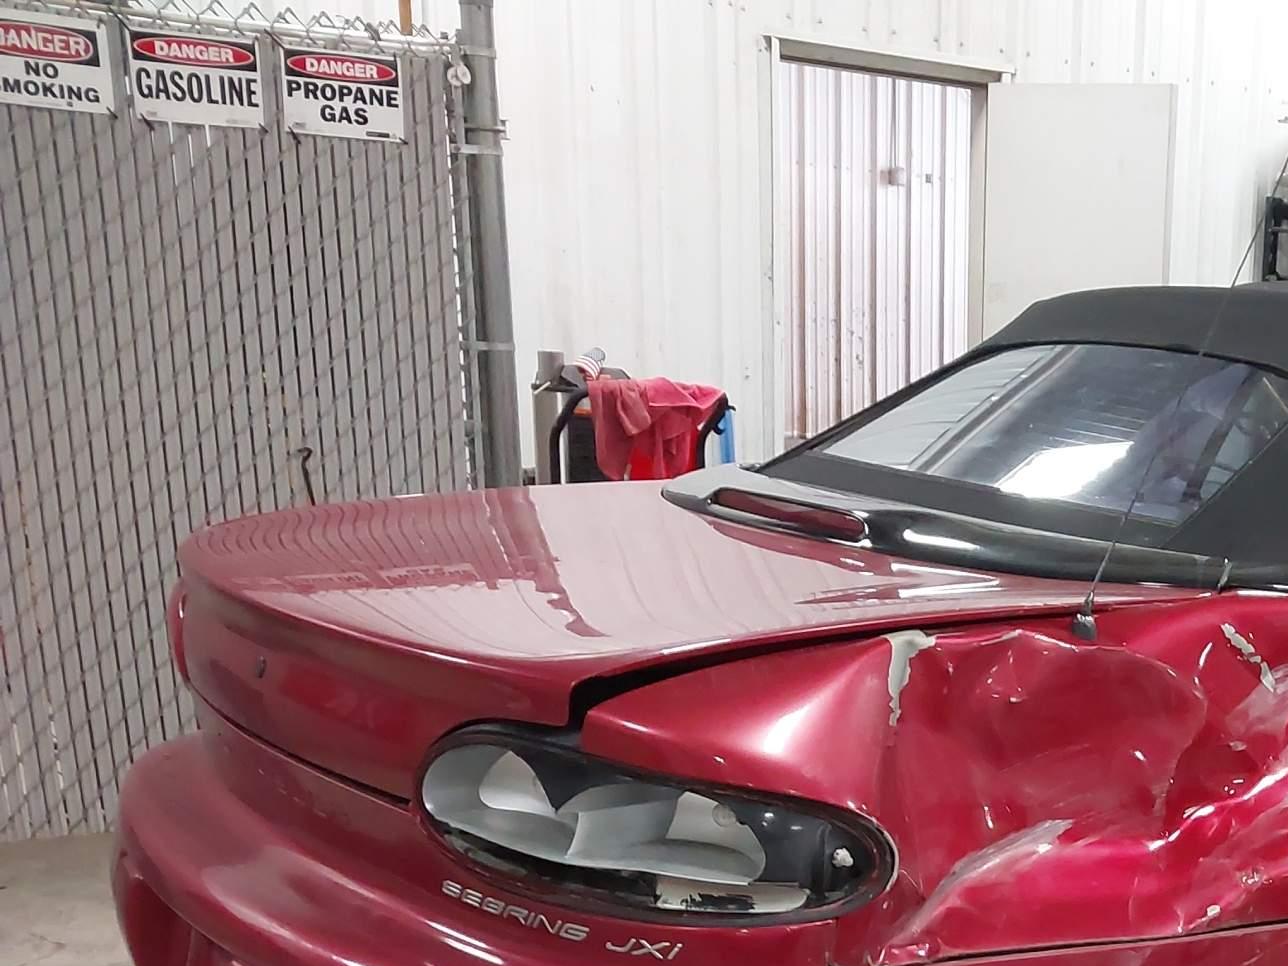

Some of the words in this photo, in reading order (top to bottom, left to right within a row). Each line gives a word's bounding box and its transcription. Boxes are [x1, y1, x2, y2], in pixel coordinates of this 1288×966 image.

[153, 40, 235, 63] DANGER
[24, 60, 59, 79] NO
[304, 57, 379, 79] DANGER
[0, 76, 100, 103] MOKING
[135, 67, 260, 108] GASOLINE
[286, 79, 400, 108] PROPANE
[320, 104, 369, 126] GAS
[441, 880, 590, 941] SEBRING
